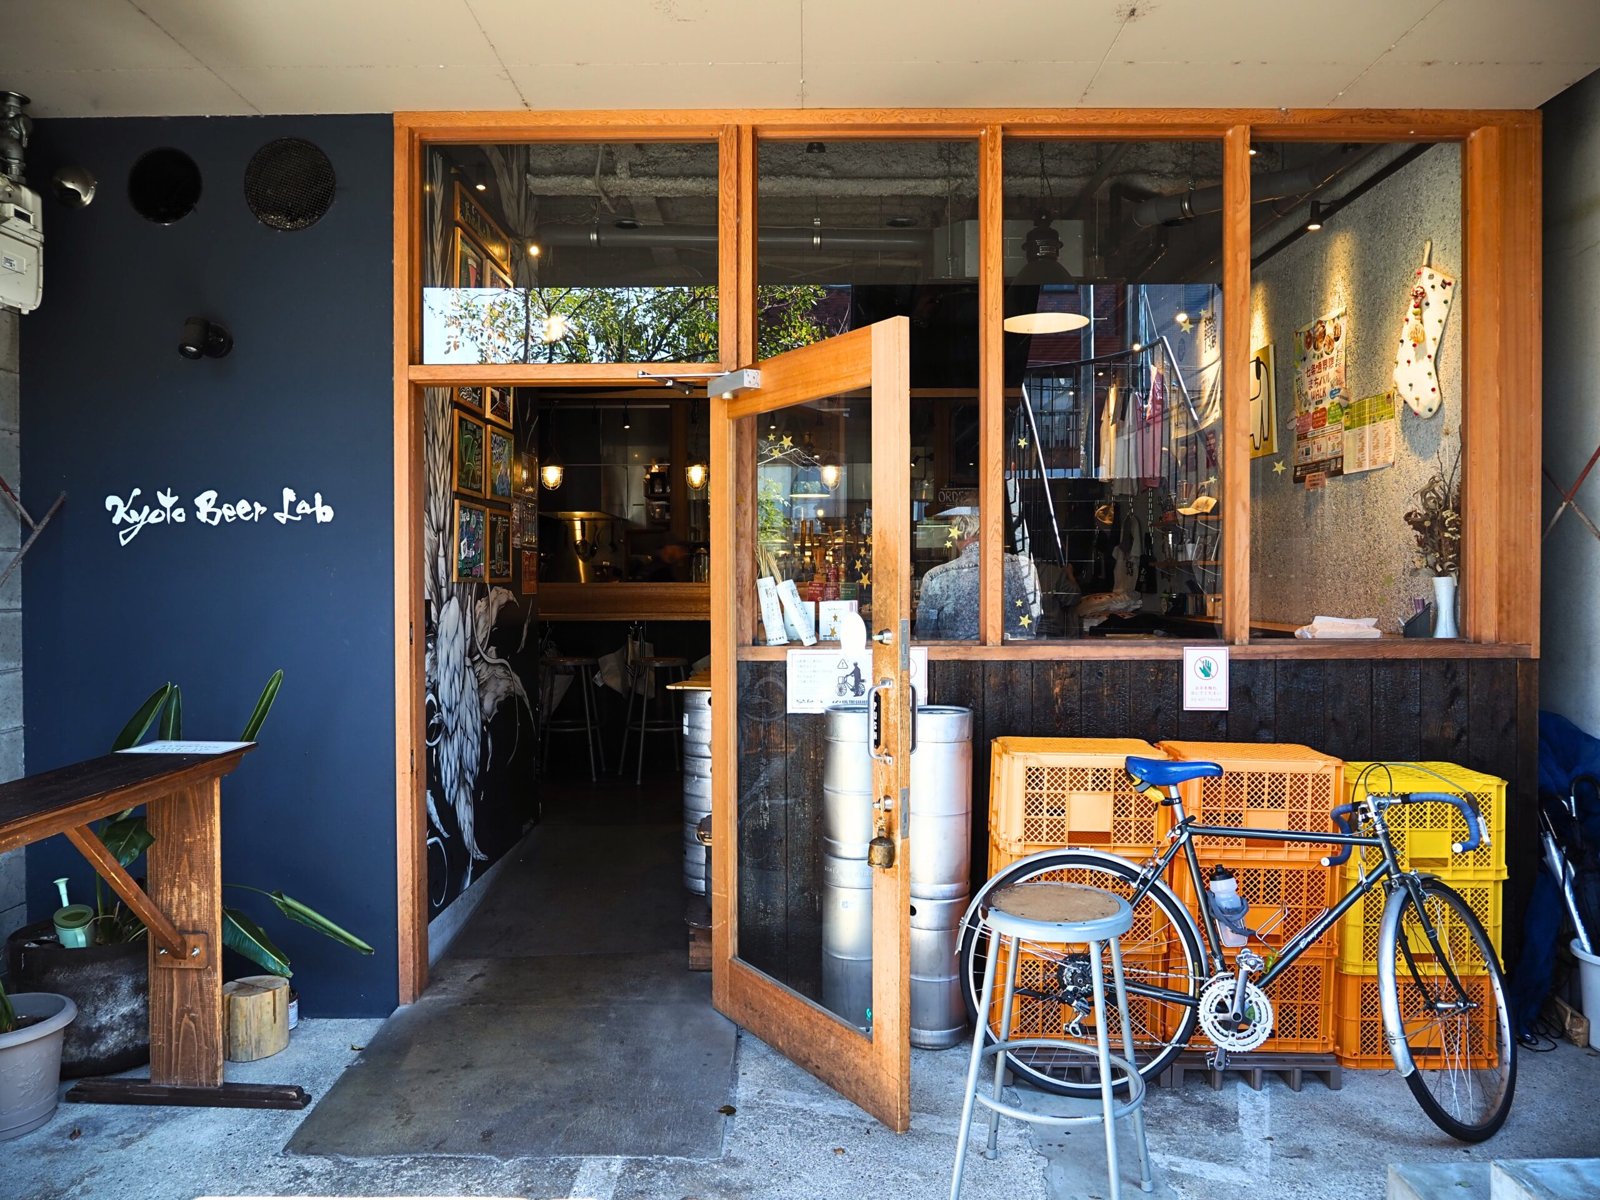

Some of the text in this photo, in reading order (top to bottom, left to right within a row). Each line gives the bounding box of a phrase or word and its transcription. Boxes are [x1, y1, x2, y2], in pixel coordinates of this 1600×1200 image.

[105, 487, 334, 547] Kyoto Beer Lab
